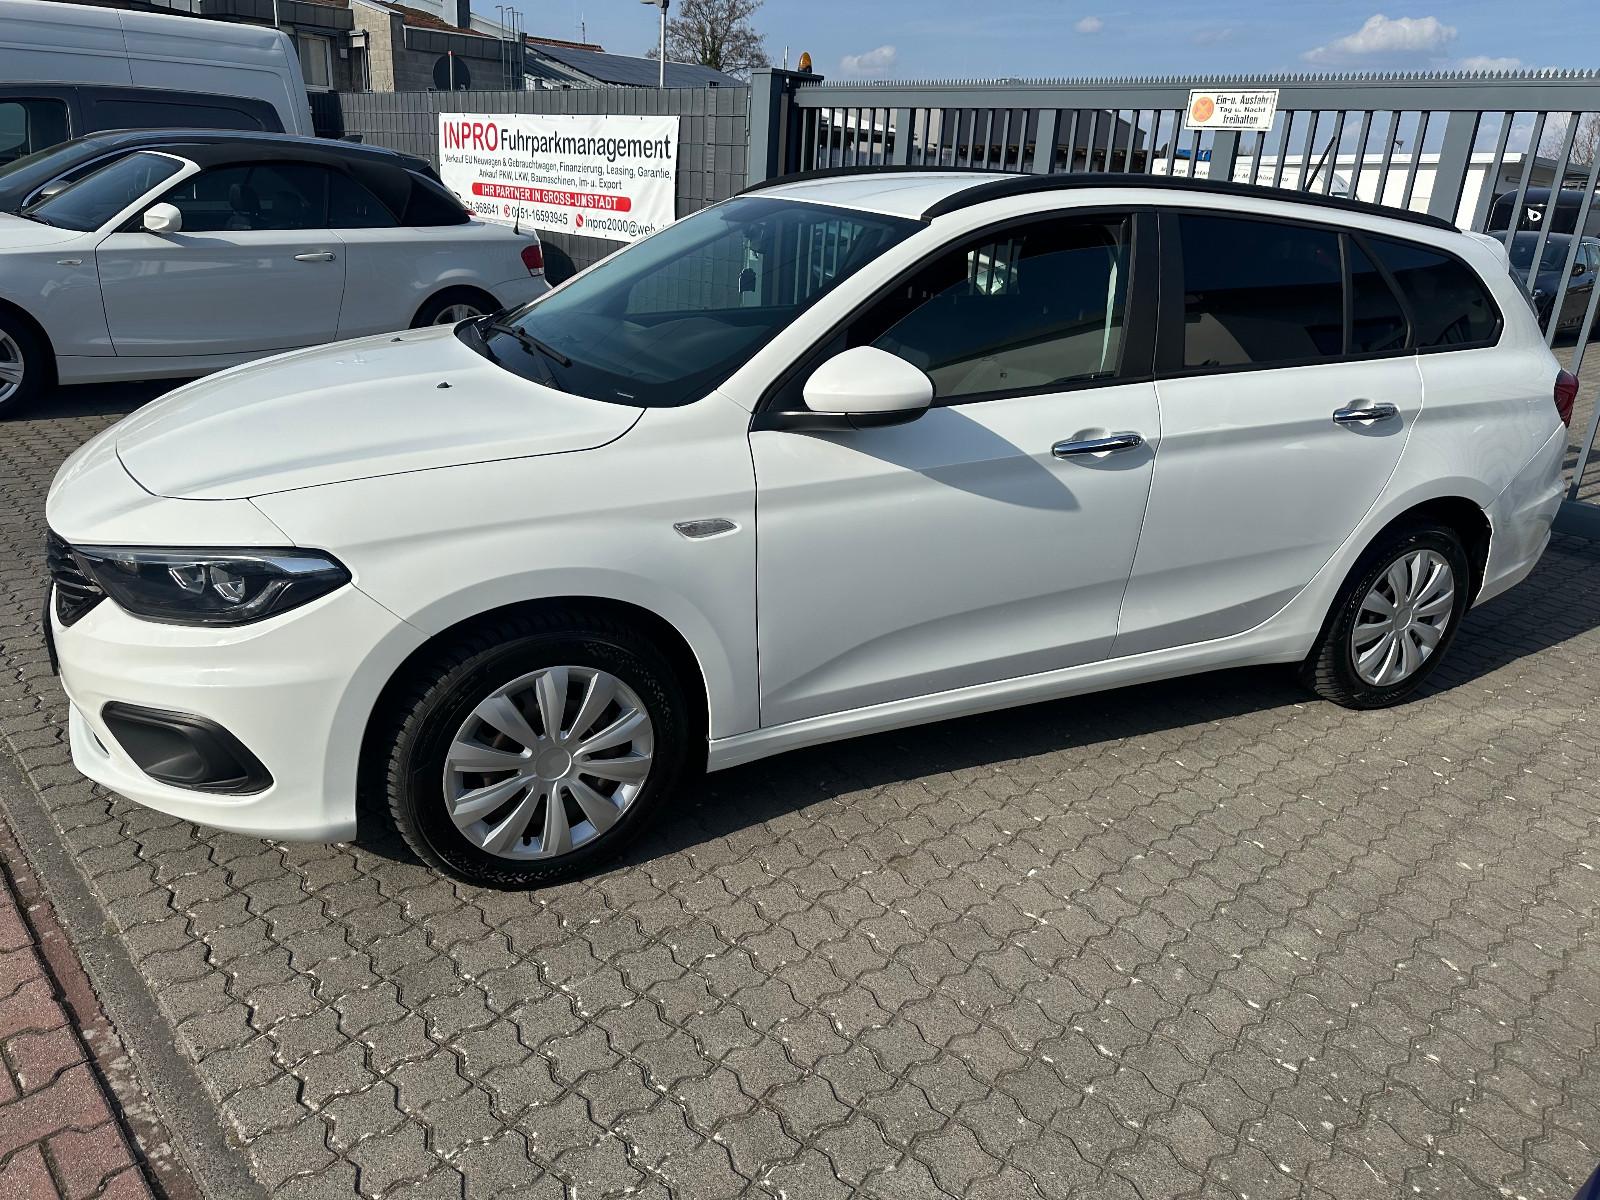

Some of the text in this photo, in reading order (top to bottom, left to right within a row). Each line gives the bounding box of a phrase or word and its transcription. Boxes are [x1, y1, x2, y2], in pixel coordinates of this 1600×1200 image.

[1219, 106, 1233, 114] Tag
[1222, 114, 1259, 125] freihalten
[443, 121, 672, 162] INPRO Fuhrparkmanagement
[444, 153, 672, 180] Verkauf EU Neuwagen & Gebrauchtwagen, Finanzierung, Leasing, Garantie,
[478, 169, 498, 179] Ankauf
[498, 170, 514, 181] PKW,
[514, 172, 530, 183] LKW,
[530, 173, 578, 188] Baumaschinen,
[598, 178, 623, 191] Export
[481, 184, 618, 210] IHR PARTNER IN GROSS-UMSTADT
[585, 215, 656, 237] inpro2000@web
